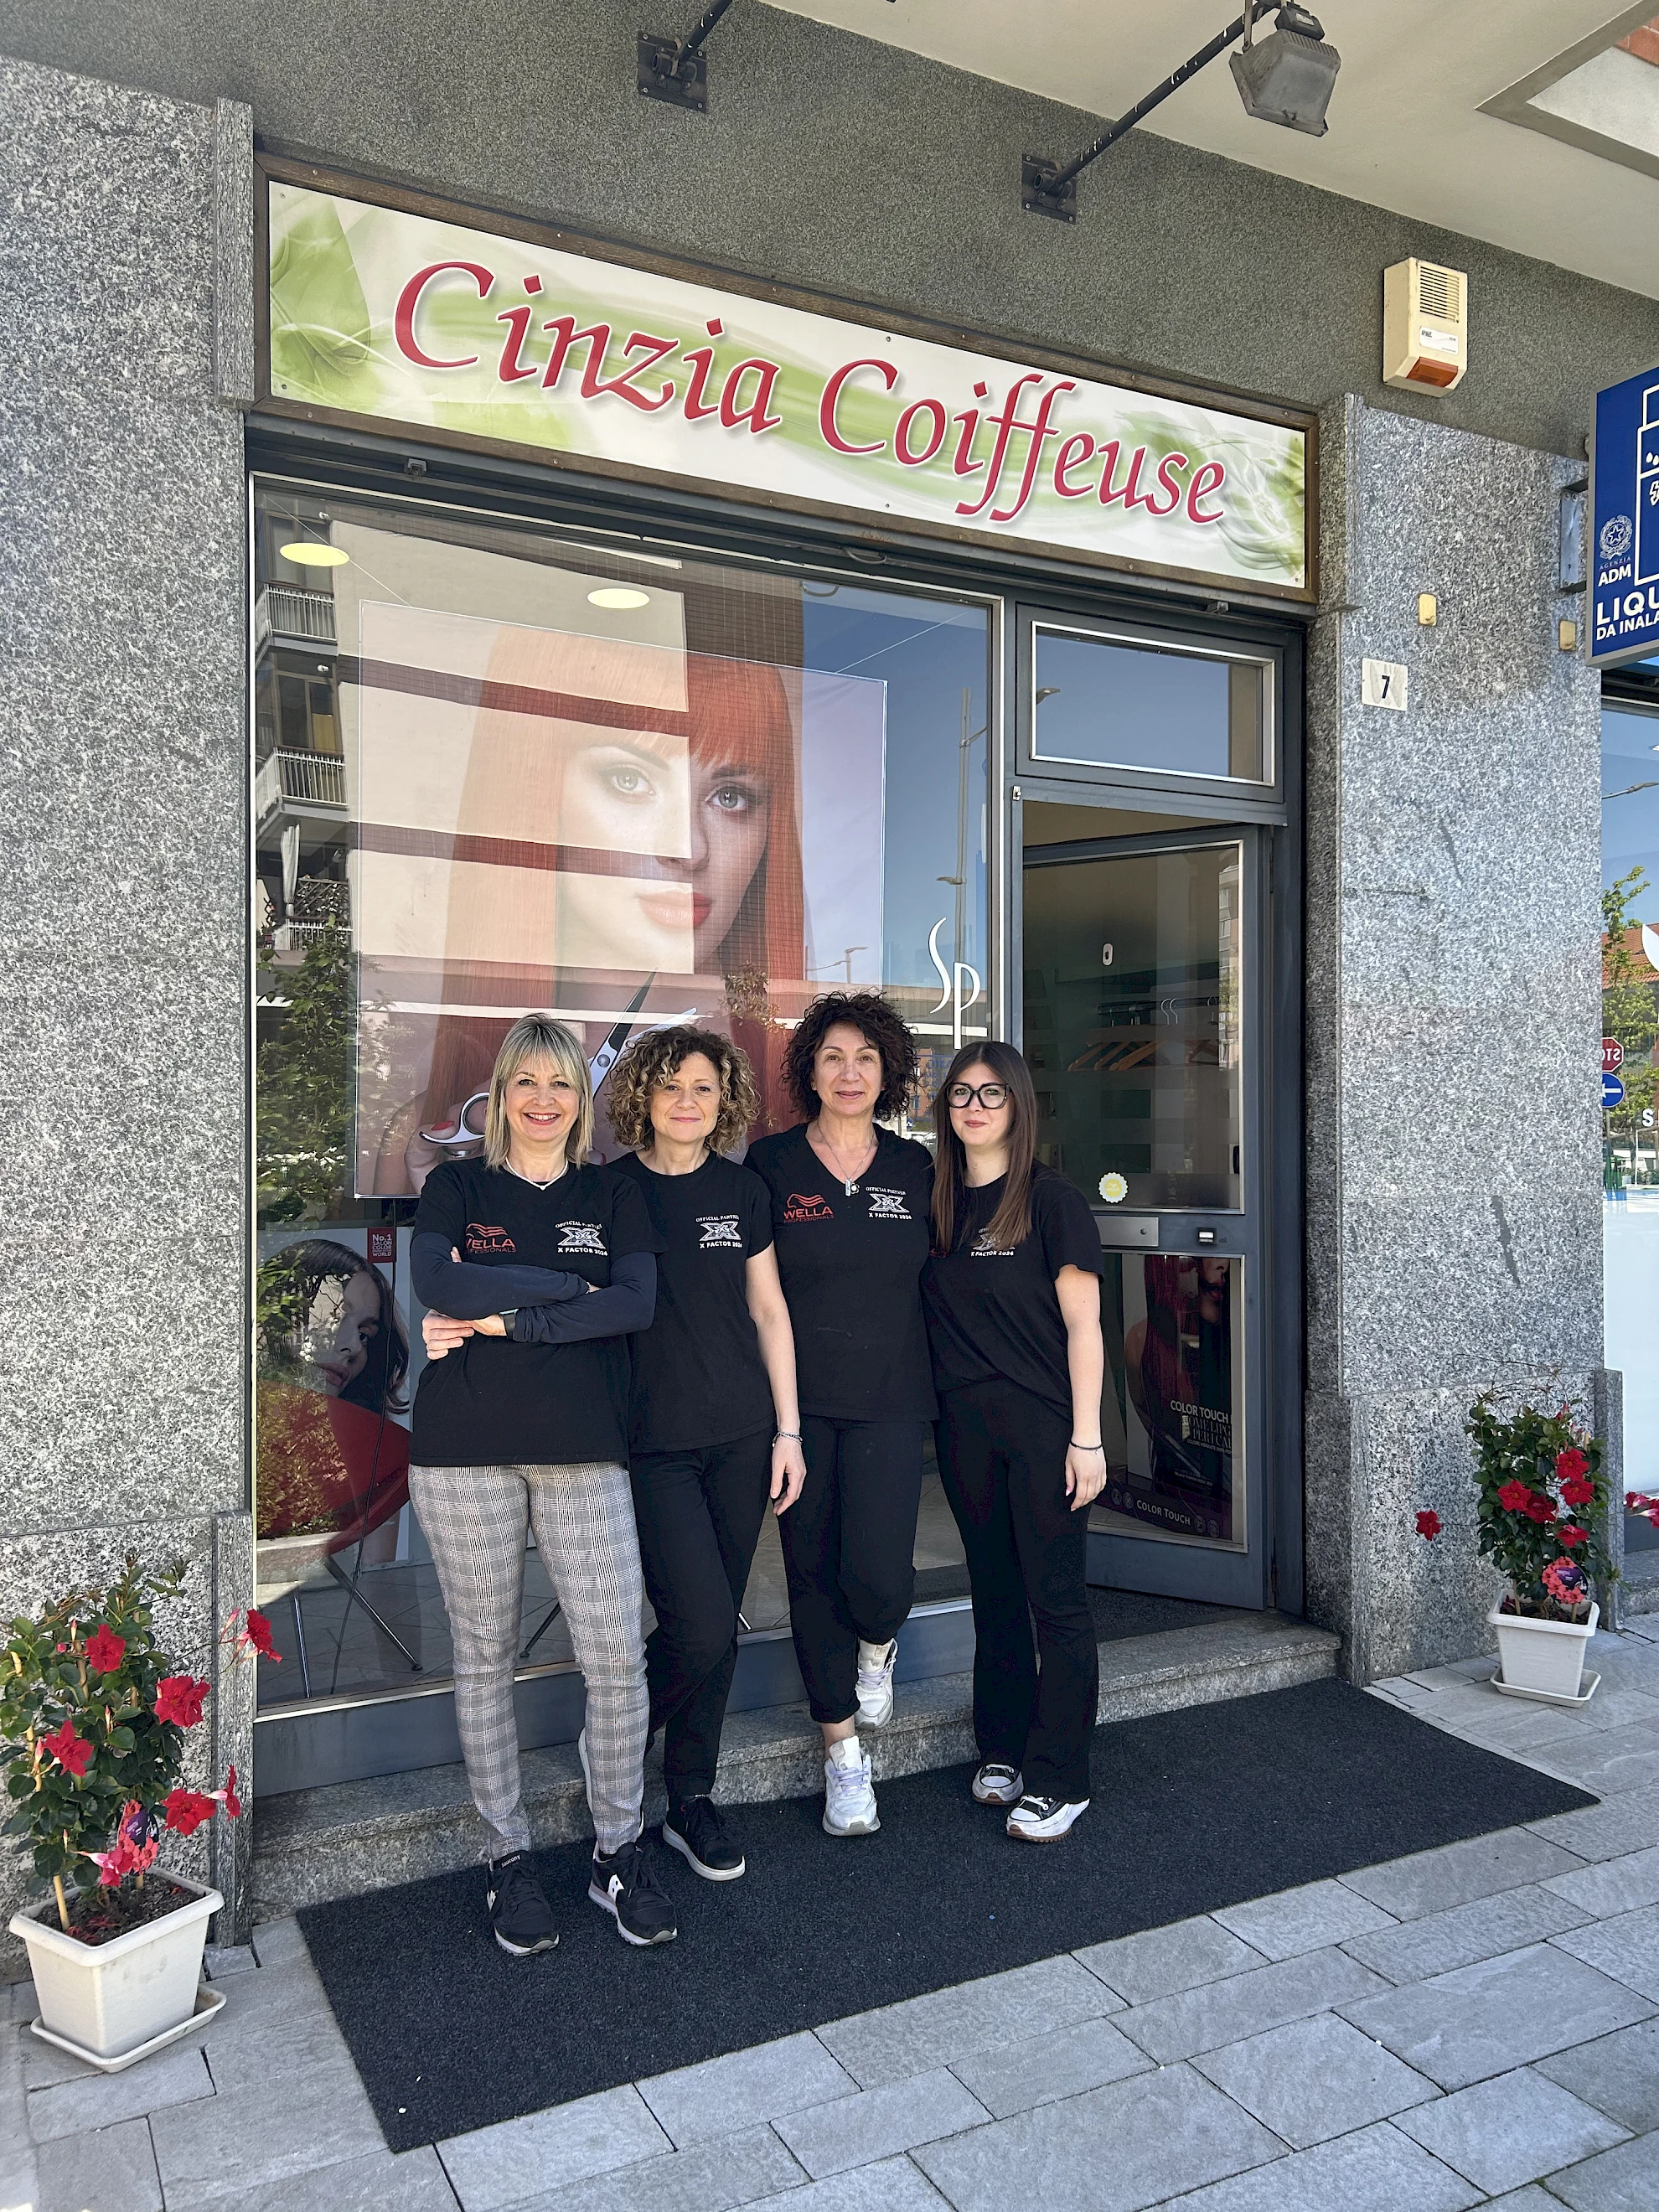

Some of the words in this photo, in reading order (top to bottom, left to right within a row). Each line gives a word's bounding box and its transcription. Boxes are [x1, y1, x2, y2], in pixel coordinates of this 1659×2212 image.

[394, 261, 782, 433] Cinzia
[820, 359, 1226, 524] Coiffeuse
[1598, 563, 1631, 587] ADM
[1600, 556, 1631, 571] AGENZIA
[1596, 623, 1616, 641] DA
[1382, 675, 1390, 699] 7
[555, 1220, 581, 1228] OFFICIAL
[783, 1206, 834, 1220] WELLA
[1170, 1400, 1198, 1416] COLOR
[1199, 1407, 1229, 1424] TOUCH
[1136, 1499, 1162, 1517] COLOR
[1164, 1508, 1191, 1526] TOUCH
